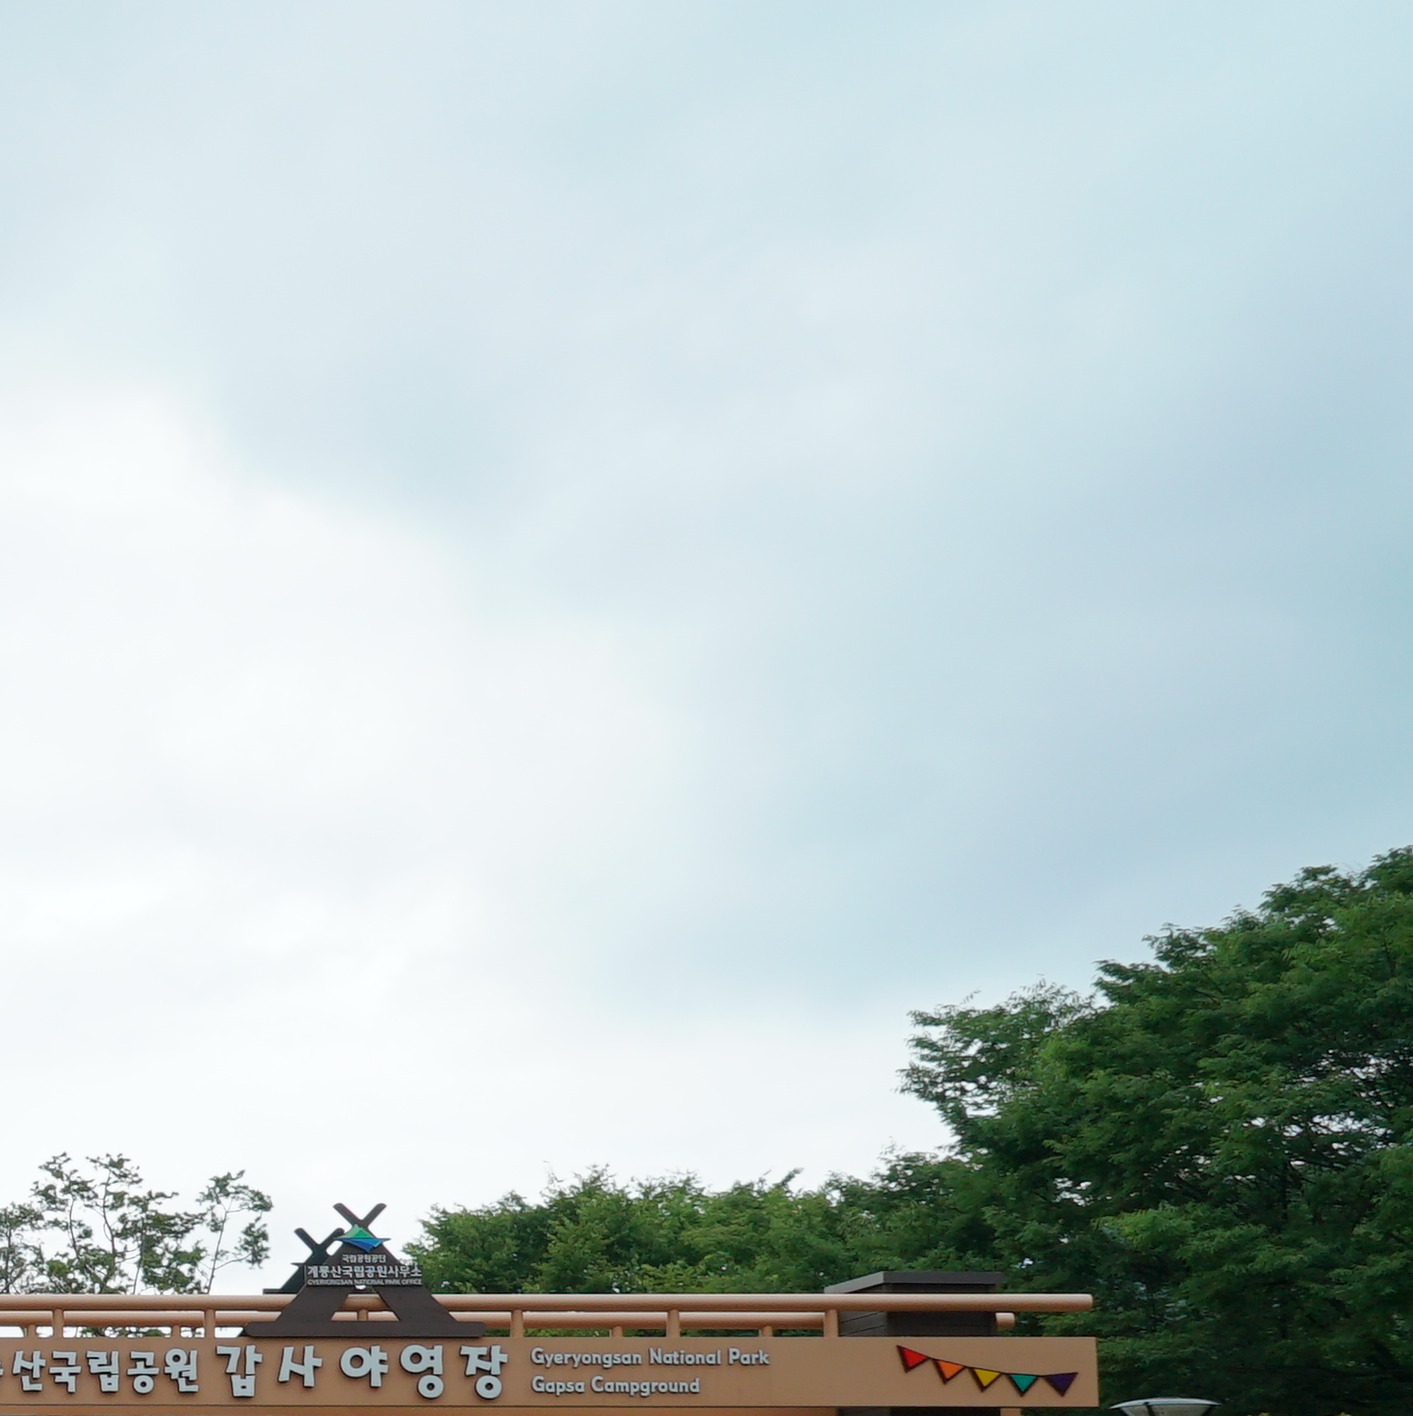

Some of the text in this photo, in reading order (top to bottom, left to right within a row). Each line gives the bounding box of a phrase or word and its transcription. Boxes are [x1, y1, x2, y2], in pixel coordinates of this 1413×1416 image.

[307, 1265, 422, 1278] 계룡산국립공원사무소
[530, 1347, 770, 1368] Gyeryongsan National Park
[531, 1375, 701, 1397] Gapsa Campground
